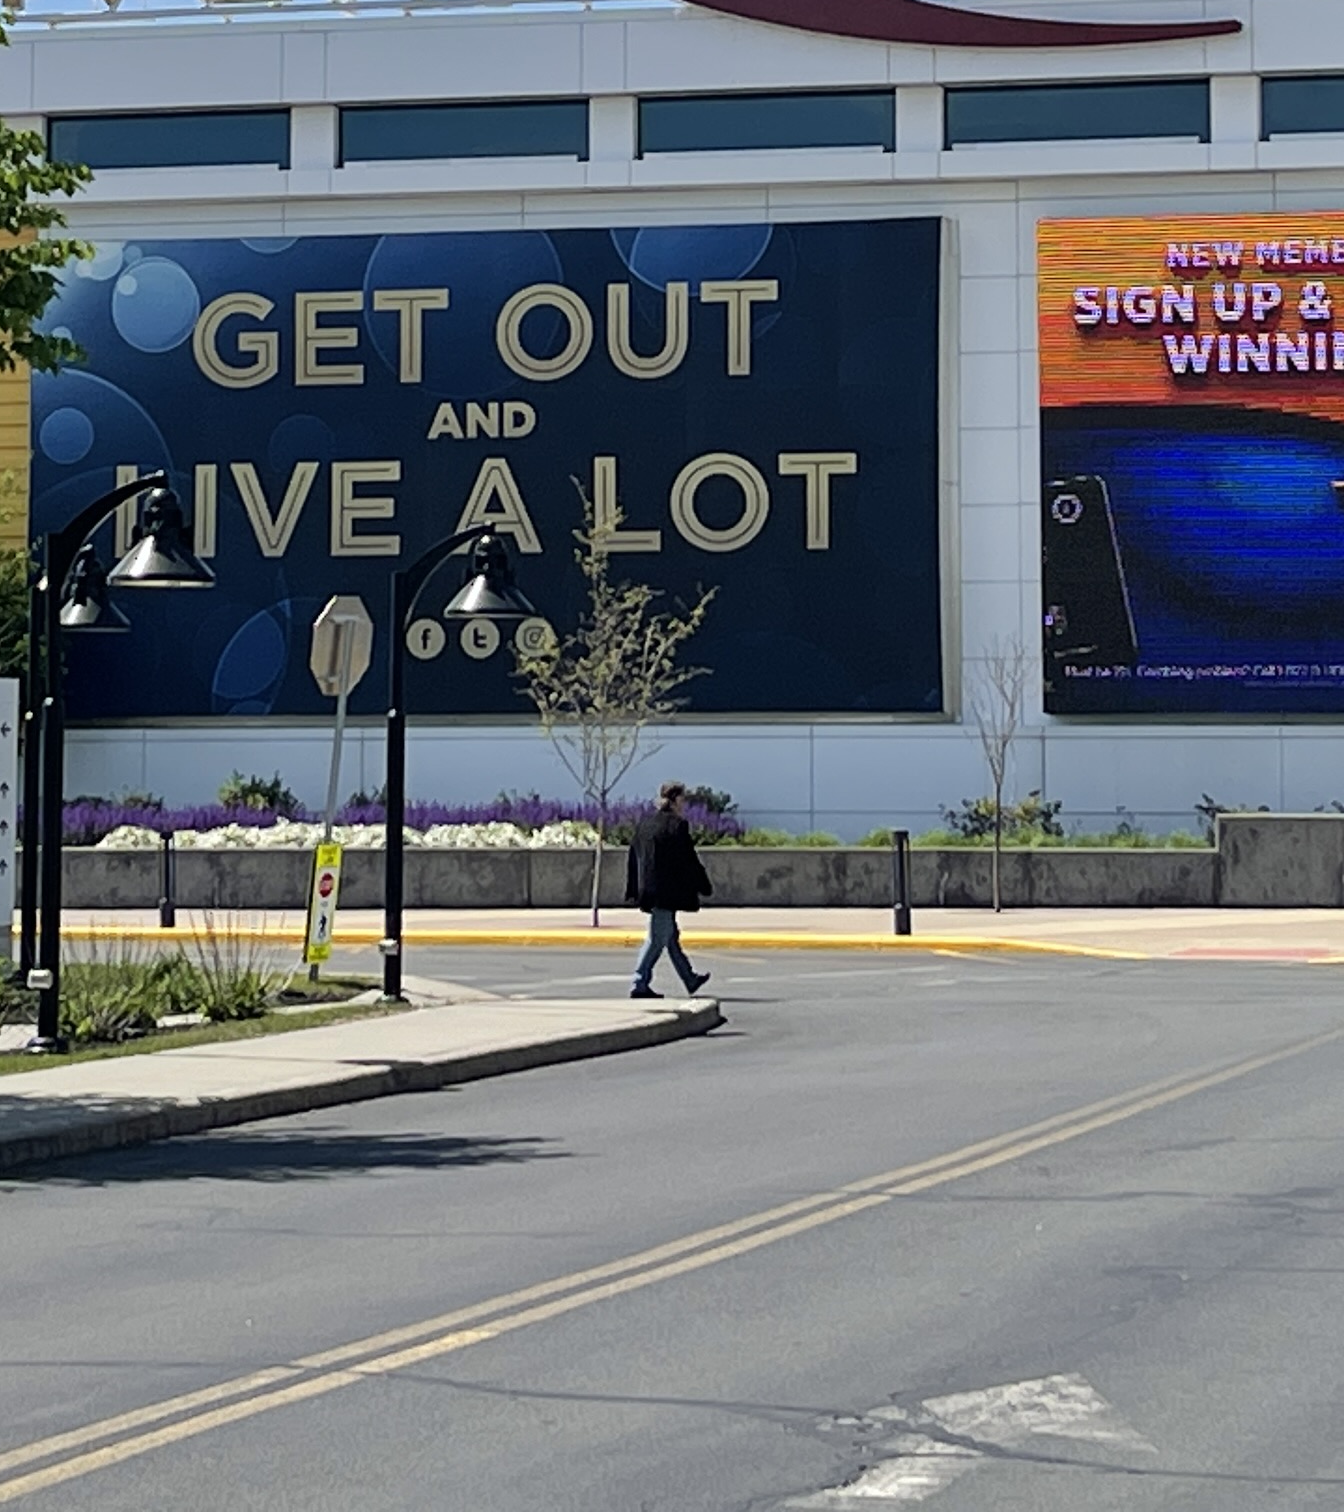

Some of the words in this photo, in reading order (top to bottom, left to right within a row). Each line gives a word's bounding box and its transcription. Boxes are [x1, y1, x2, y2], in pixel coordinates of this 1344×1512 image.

[1166, 241, 1245, 268] NEW
[1072, 284, 1195, 325] SIGN
[1212, 281, 1283, 323] UP
[1299, 280, 1333, 322] &
[192, 287, 450, 389] GET
[495, 278, 779, 382] OUT
[427, 402, 537, 440] AND
[453, 457, 544, 555] A
[592, 451, 857, 554] LOT
